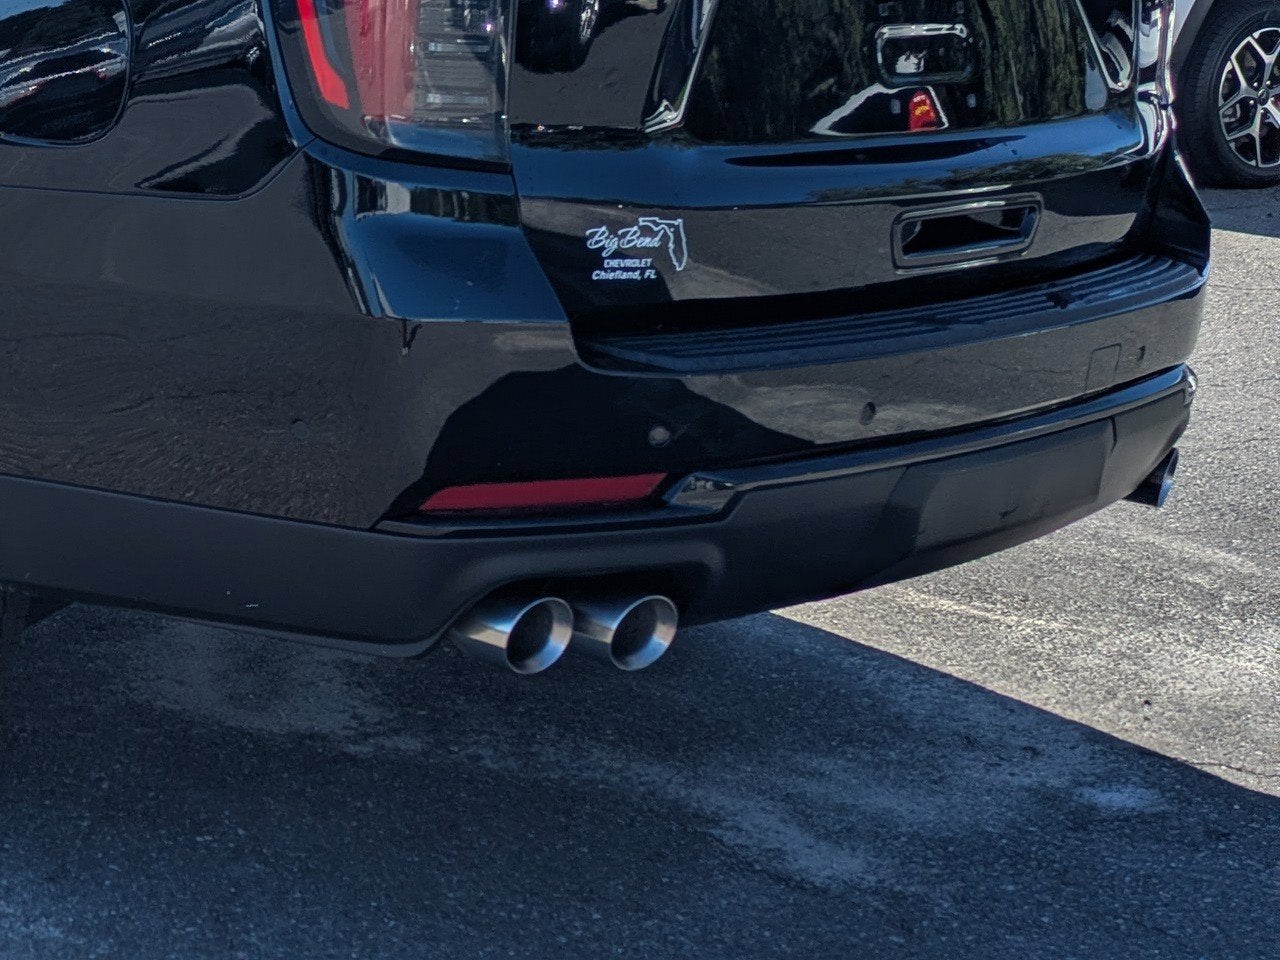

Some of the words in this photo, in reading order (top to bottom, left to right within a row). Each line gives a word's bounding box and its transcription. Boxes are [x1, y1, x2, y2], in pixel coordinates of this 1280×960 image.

[585, 226, 618, 257] Big
[617, 226, 665, 249] Bend
[603, 258, 653, 268] CHEVROLET
[591, 270, 641, 280] Chiefland,
[643, 270, 658, 279] FL
